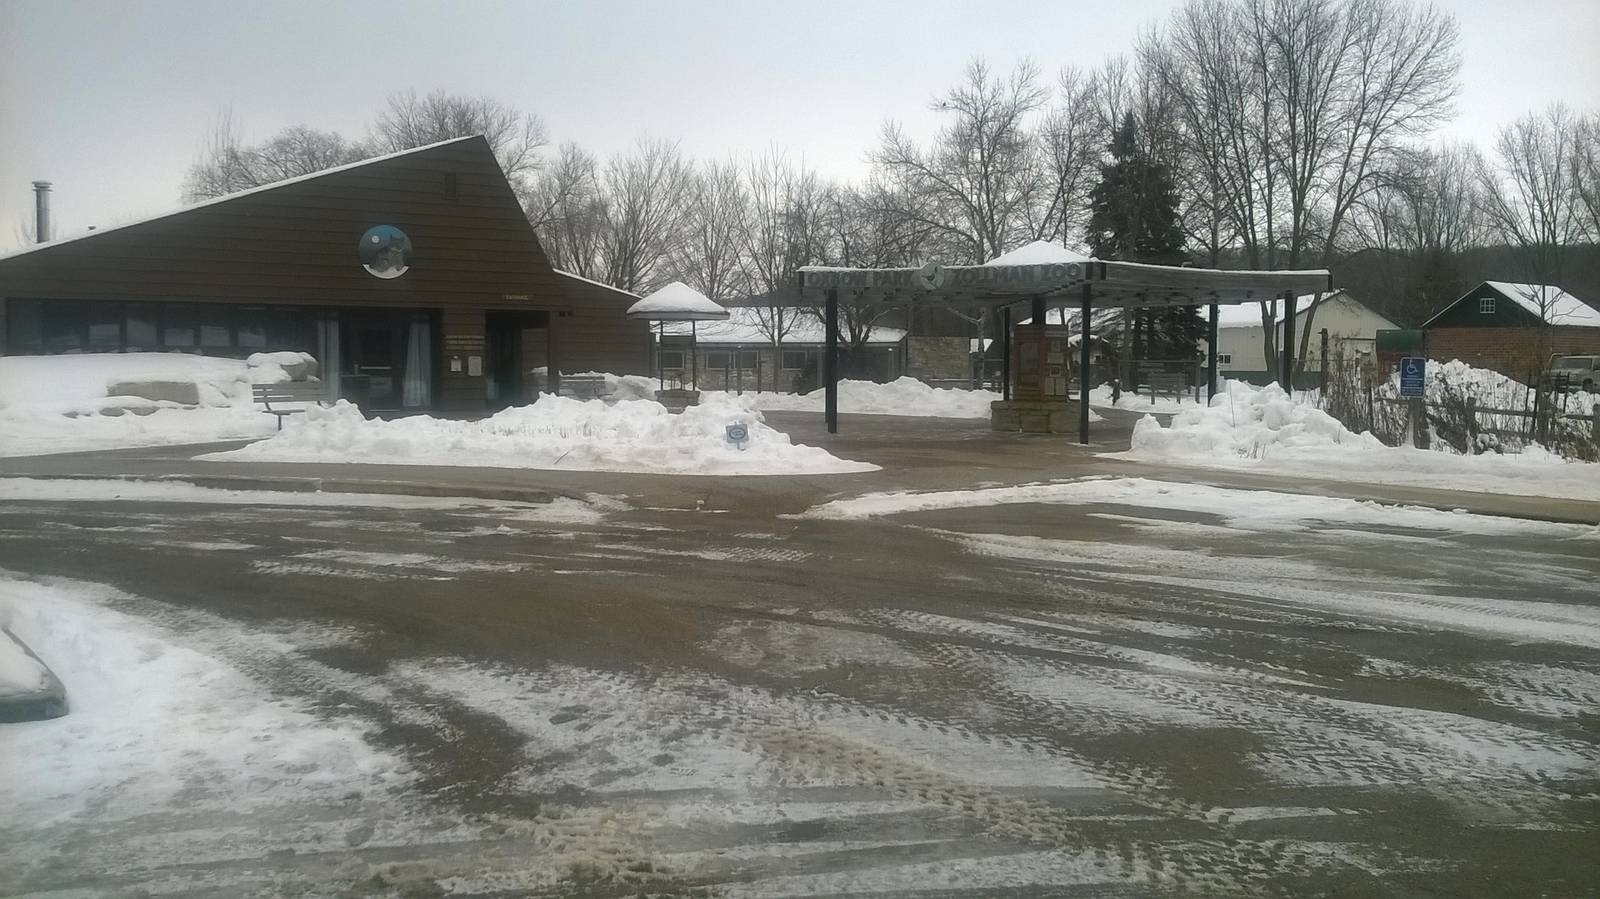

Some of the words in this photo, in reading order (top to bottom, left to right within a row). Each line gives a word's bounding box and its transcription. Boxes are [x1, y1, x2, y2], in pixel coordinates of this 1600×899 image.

[806, 271, 866, 287] OXBOW
[873, 270, 914, 286] PARK
[1041, 263, 1082, 280] ZOO
